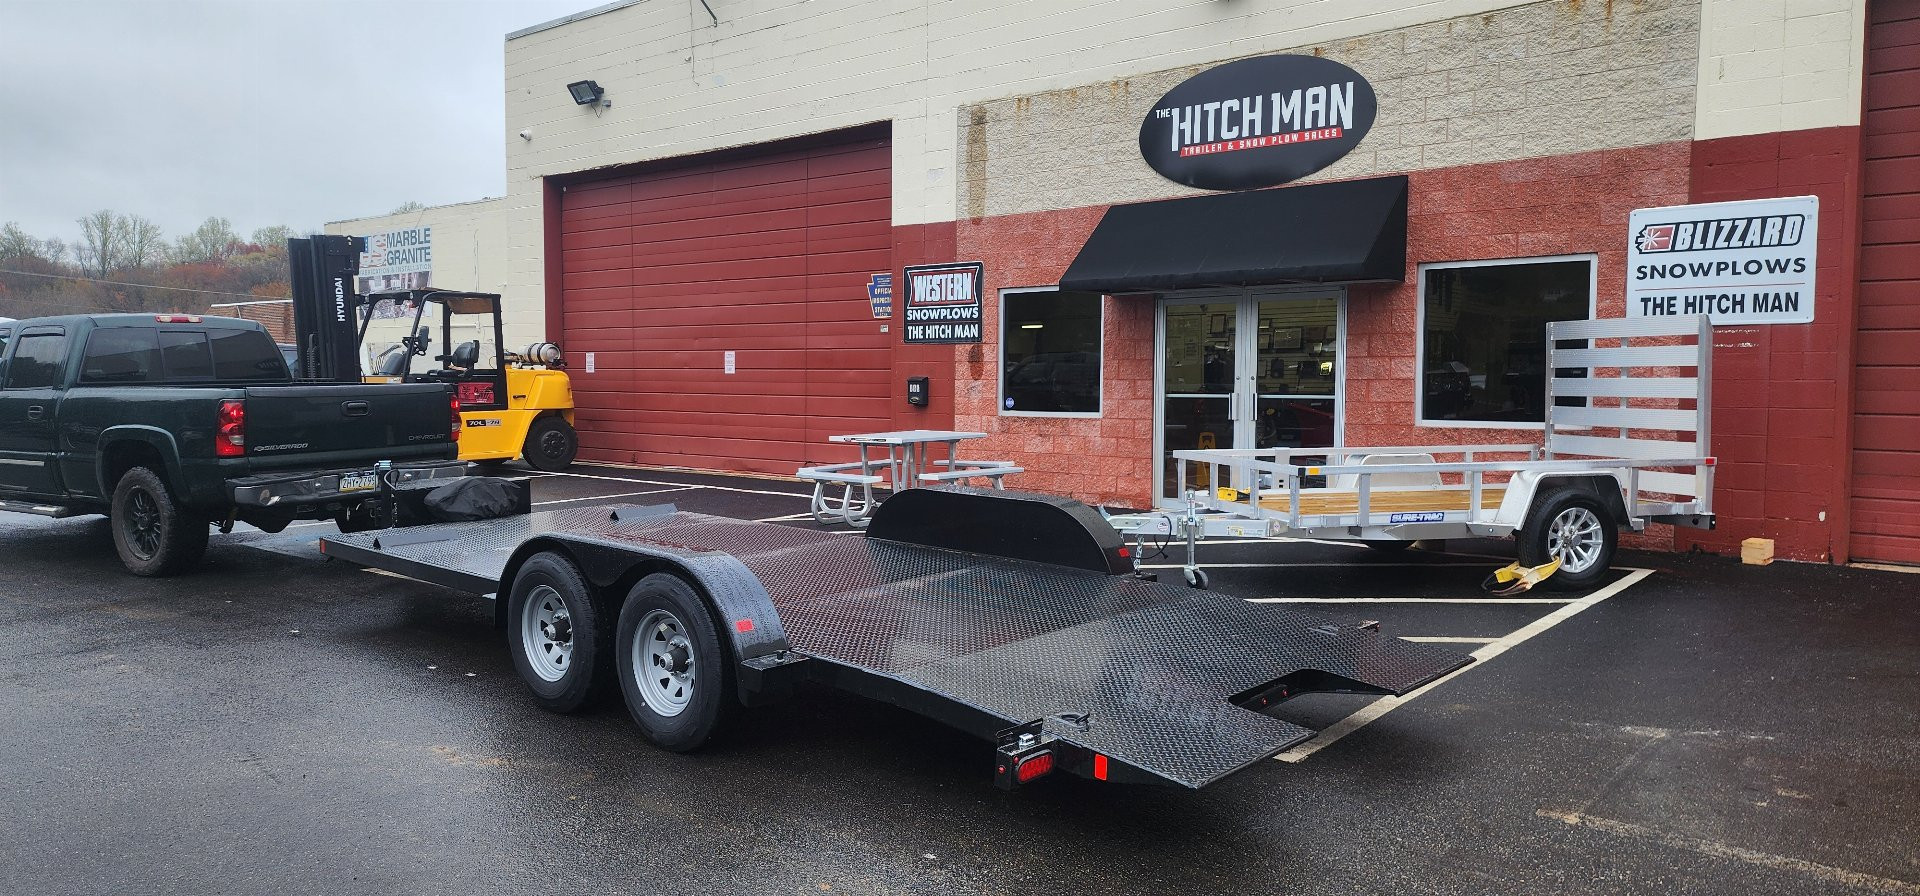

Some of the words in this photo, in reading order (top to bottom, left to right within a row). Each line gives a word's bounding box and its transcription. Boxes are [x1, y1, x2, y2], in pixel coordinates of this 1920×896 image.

[1156, 108, 1170, 118] THE
[1171, 95, 1263, 151] HITCH
[1271, 82, 1354, 133] MAN
[1184, 143, 1222, 155] TRAILER
[1239, 138, 1266, 149] SNOW
[1271, 133, 1299, 144] PLOW
[1304, 129, 1338, 140] SALES
[386, 228, 431, 248] MARBLE
[1674, 216, 1803, 250] BLIZZARD
[386, 246, 431, 266] GRANITE
[1636, 257, 1806, 280] SNOWPLOWS
[913, 272, 972, 302] WESTERN
[334, 278, 346, 321] HYUNDAI
[1640, 296, 1677, 316] THE
[1684, 294, 1745, 314] HITCH
[1752, 292, 1799, 313] MAN
[907, 307, 979, 320] SNOWPLOWS
[908, 325, 923, 339] THE
[926, 325, 952, 338] HITCH
[955, 324, 979, 338] MAN
[264, 443, 309, 451] SILVERADO
[1391, 512, 1444, 522] SURE-TRAC
